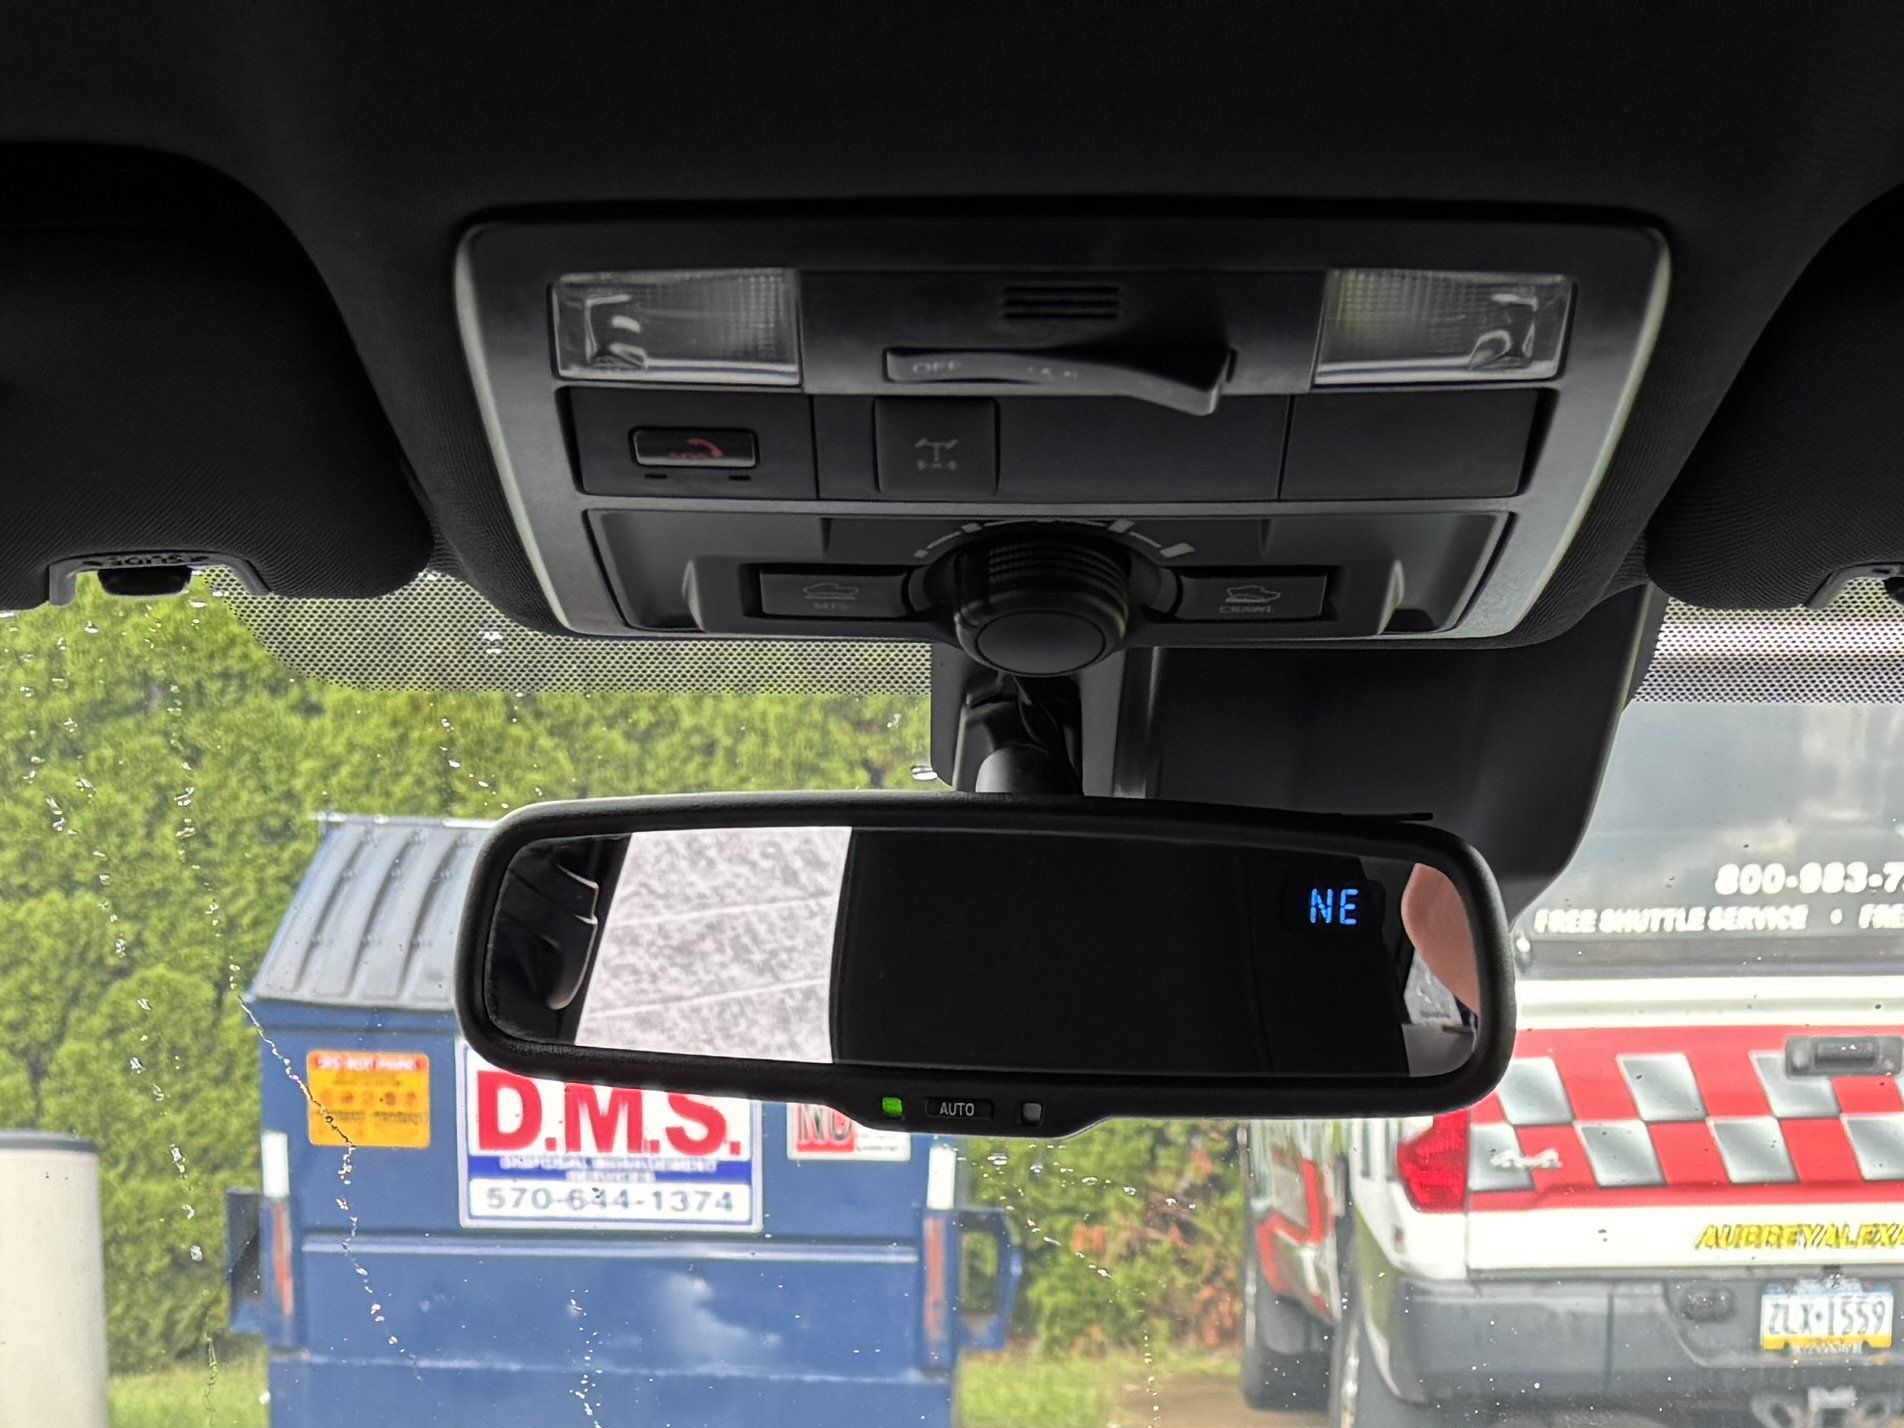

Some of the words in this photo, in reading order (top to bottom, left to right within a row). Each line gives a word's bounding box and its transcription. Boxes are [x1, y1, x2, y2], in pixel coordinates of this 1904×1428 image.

[1310, 887, 1359, 925] NE
[476, 1070, 742, 1156] D.M.S.
[938, 1100, 975, 1117] AUTO
